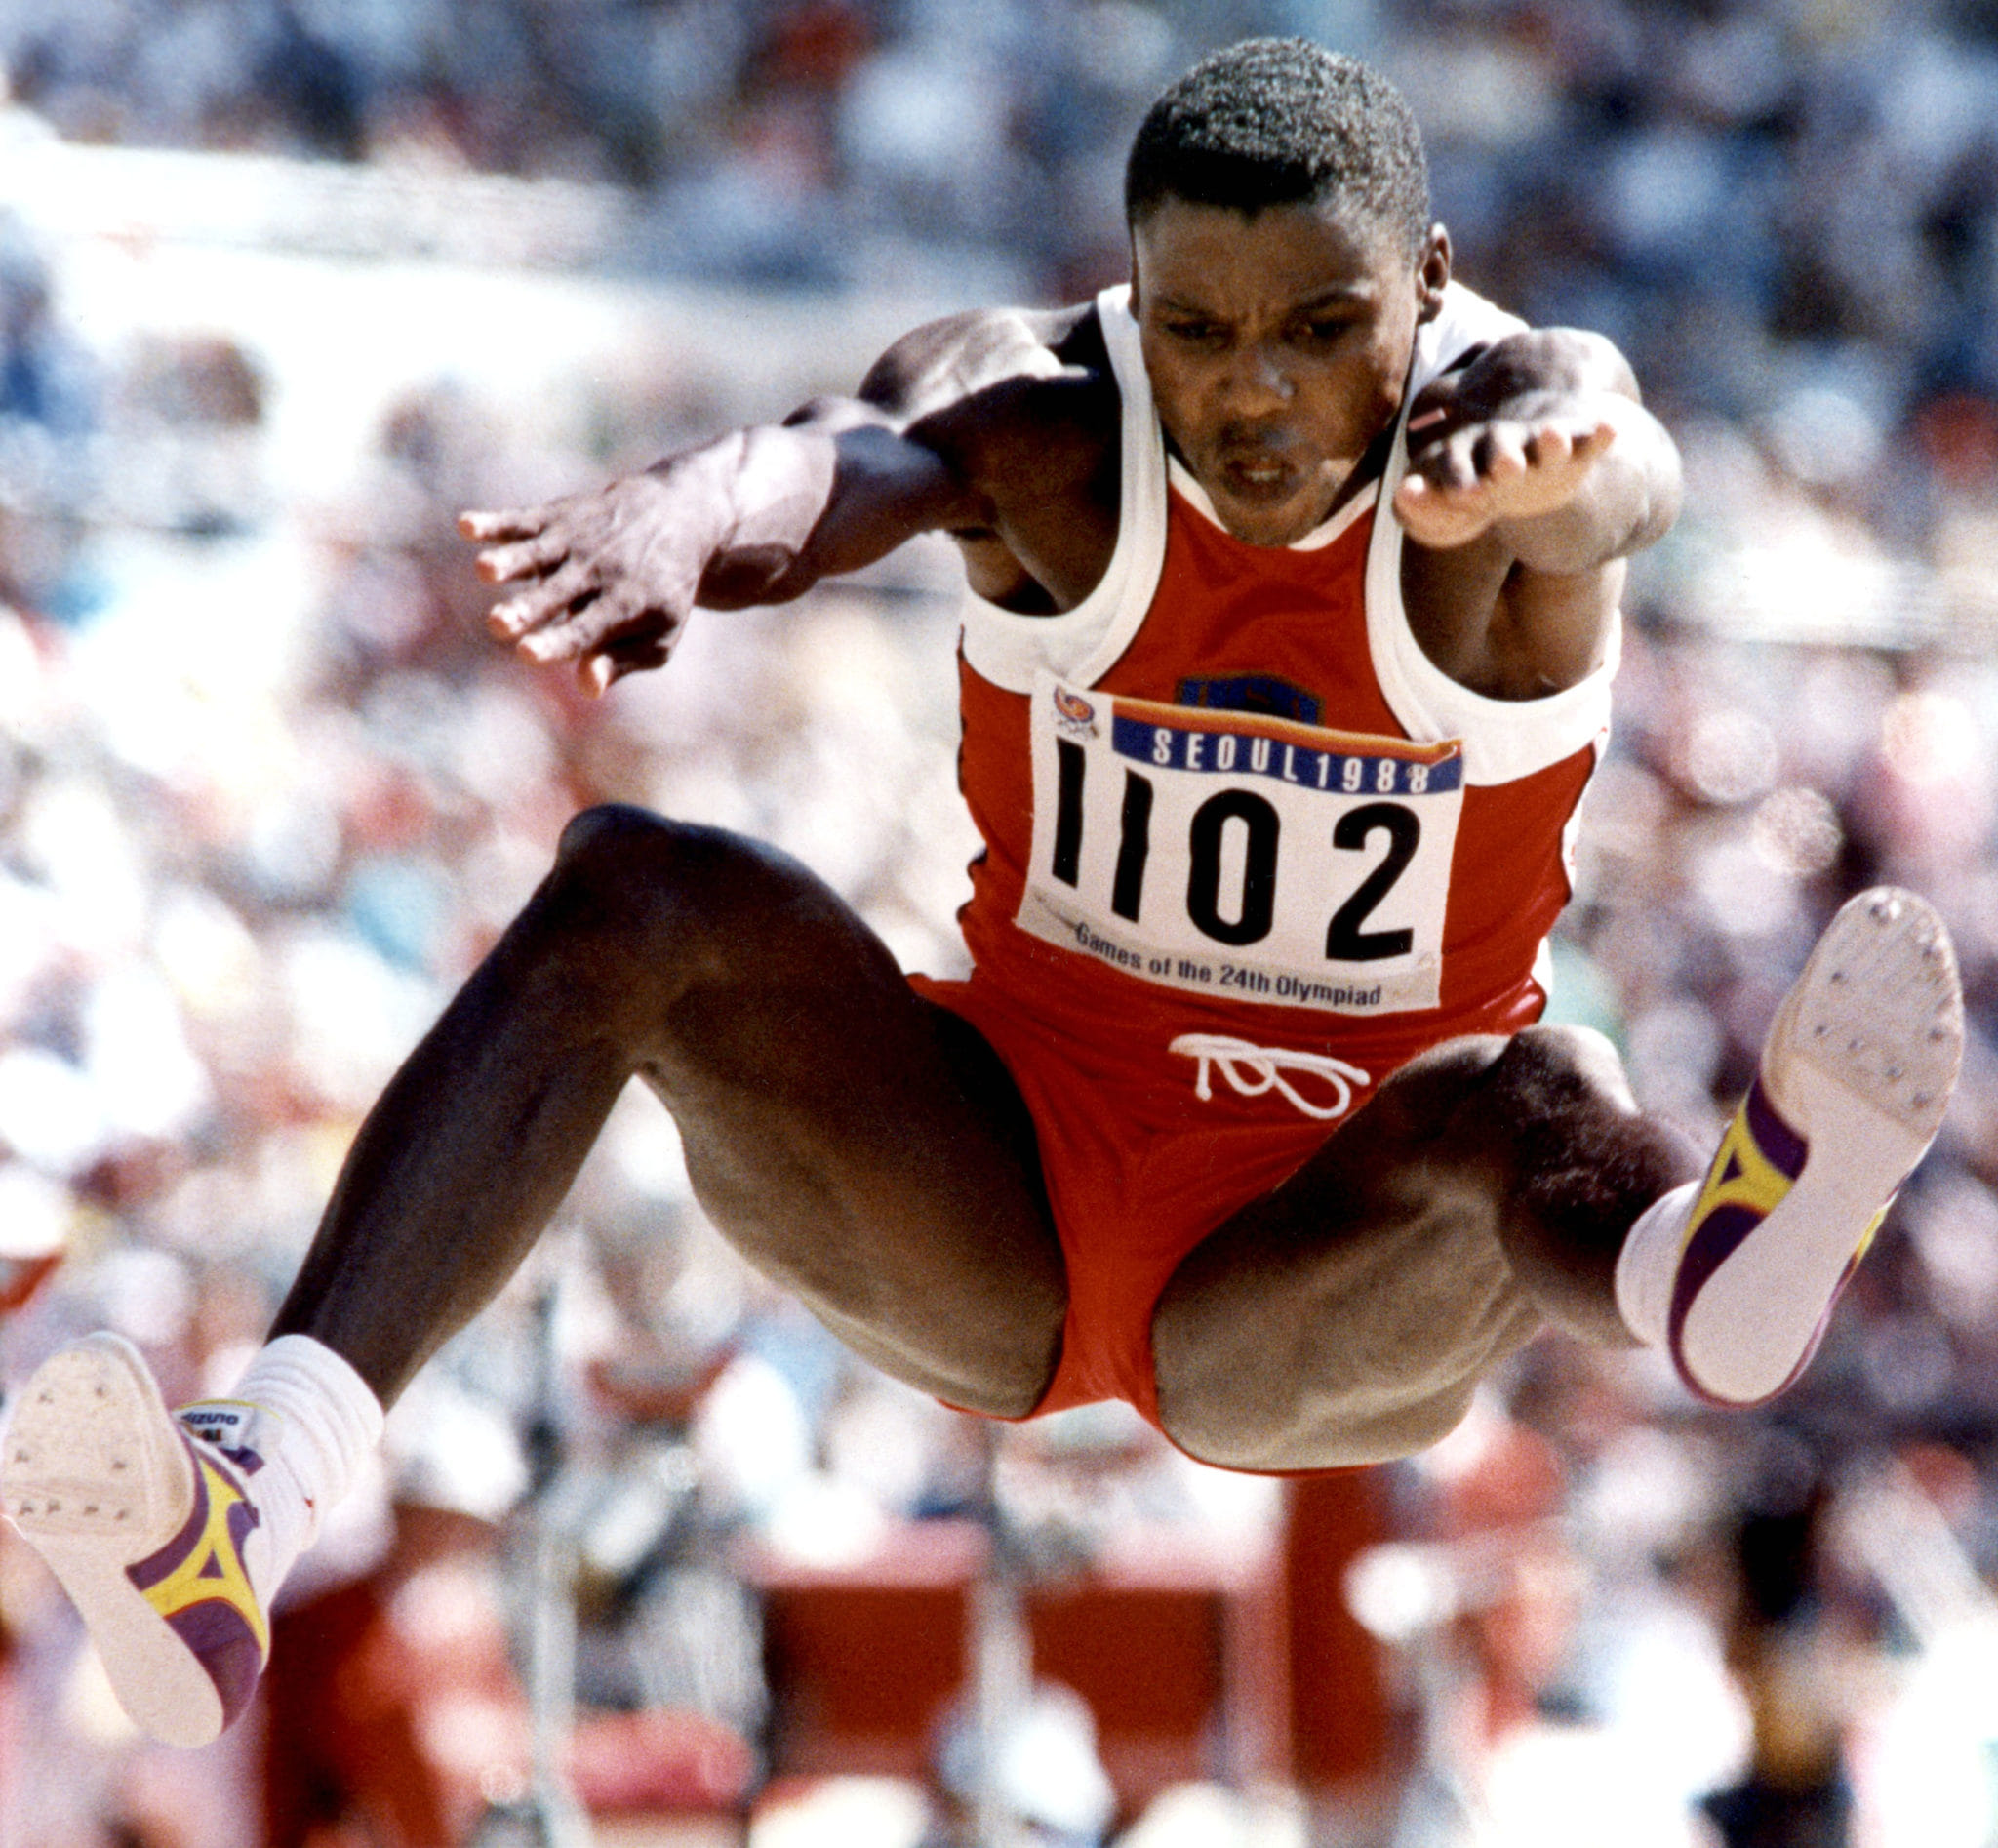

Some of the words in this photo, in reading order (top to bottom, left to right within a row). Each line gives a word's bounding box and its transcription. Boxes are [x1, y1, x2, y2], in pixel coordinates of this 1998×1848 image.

[1152, 728, 1299, 780] SEOUL
[1316, 754, 1430, 794] 1988
[1051, 735, 1421, 963] 1102
[1075, 922, 1141, 969] Games
[1149, 957, 1172, 976] of
[1178, 960, 1212, 983] the
[1219, 965, 1270, 993] 24th
[1275, 975, 1381, 1007] Olympiad
